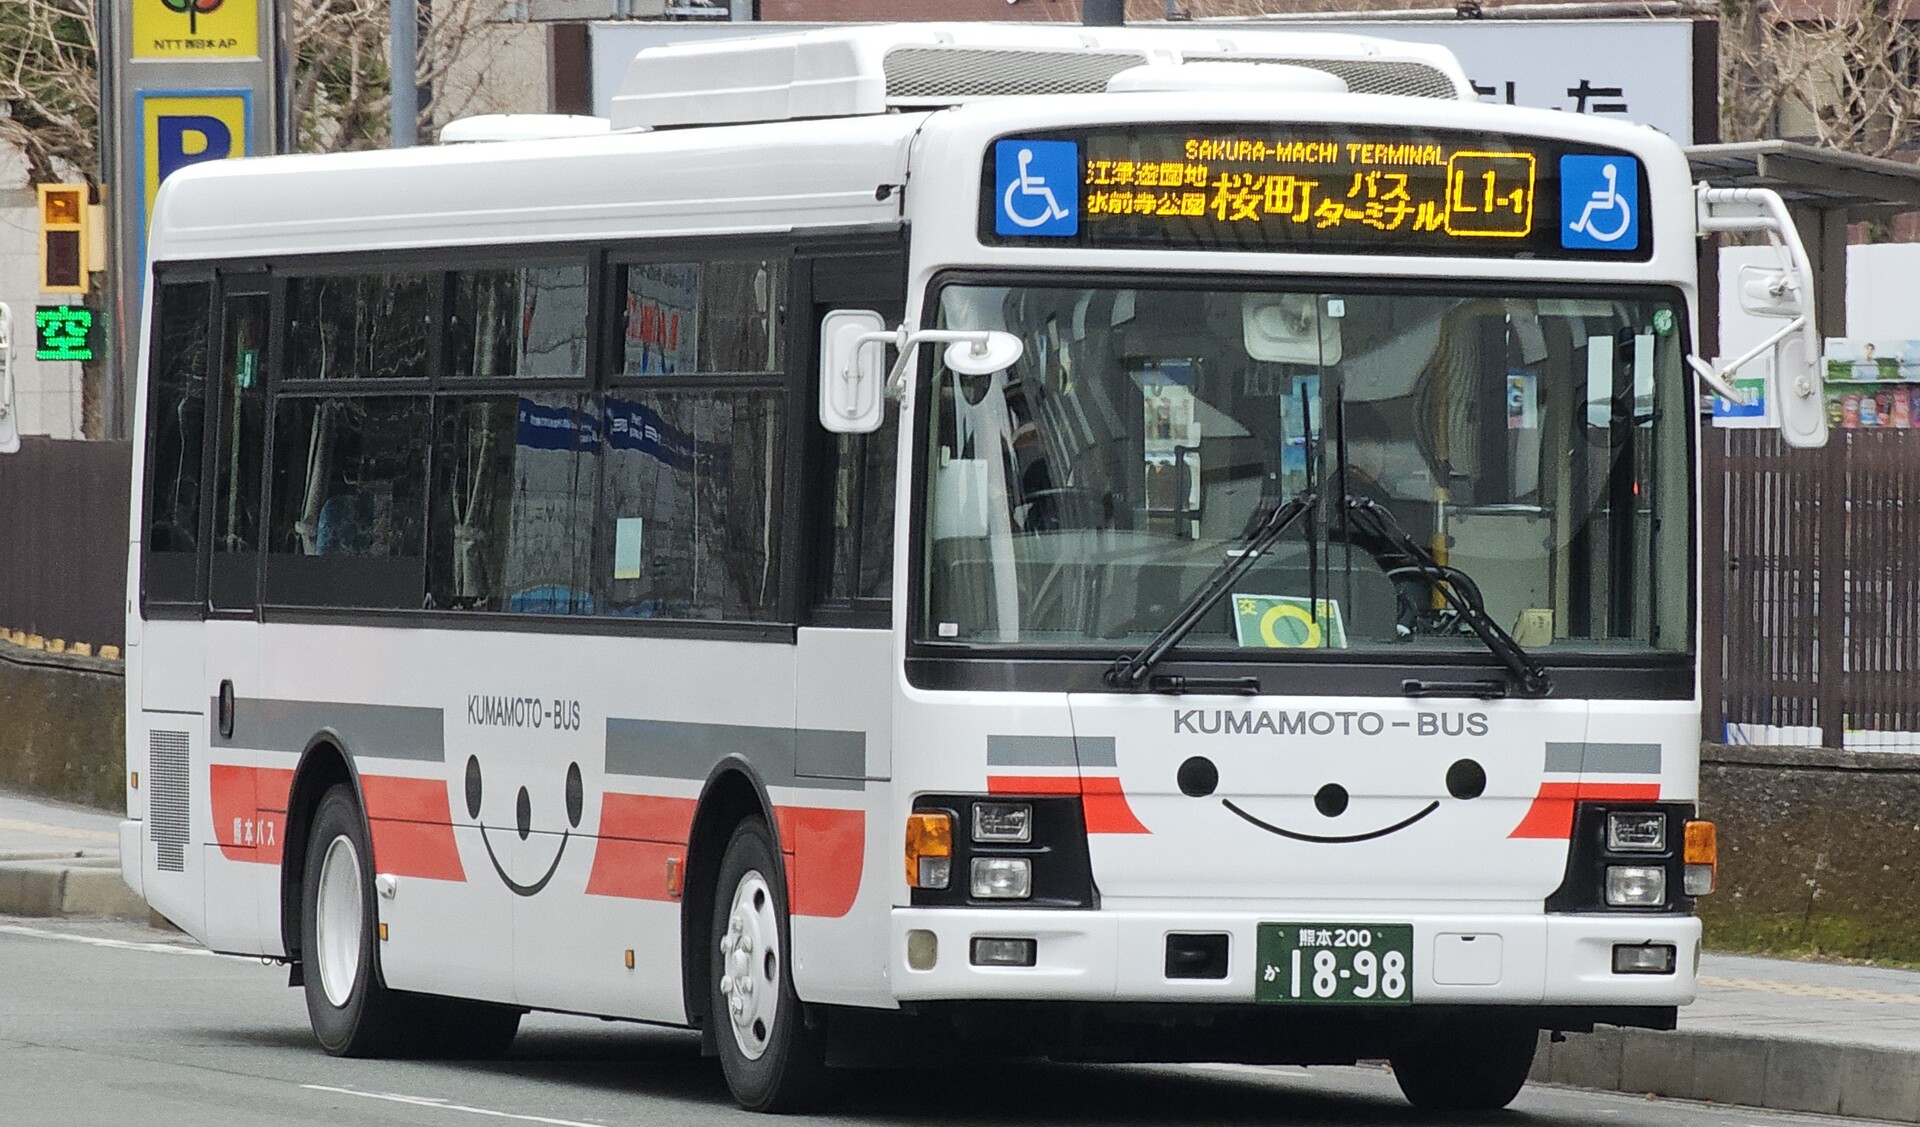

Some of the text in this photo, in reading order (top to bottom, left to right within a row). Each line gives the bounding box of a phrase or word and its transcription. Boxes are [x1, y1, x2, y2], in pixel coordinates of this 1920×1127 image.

[1185, 139, 1447, 166] SAKURA-MACHI TERMINAL
[1211, 172, 1319, 222] 桜町
[1347, 170, 1411, 201] バス
[1314, 197, 1445, 231] ターミナル
[36, 306, 92, 360] 空
[1263, 949, 1406, 998] か 18-98
